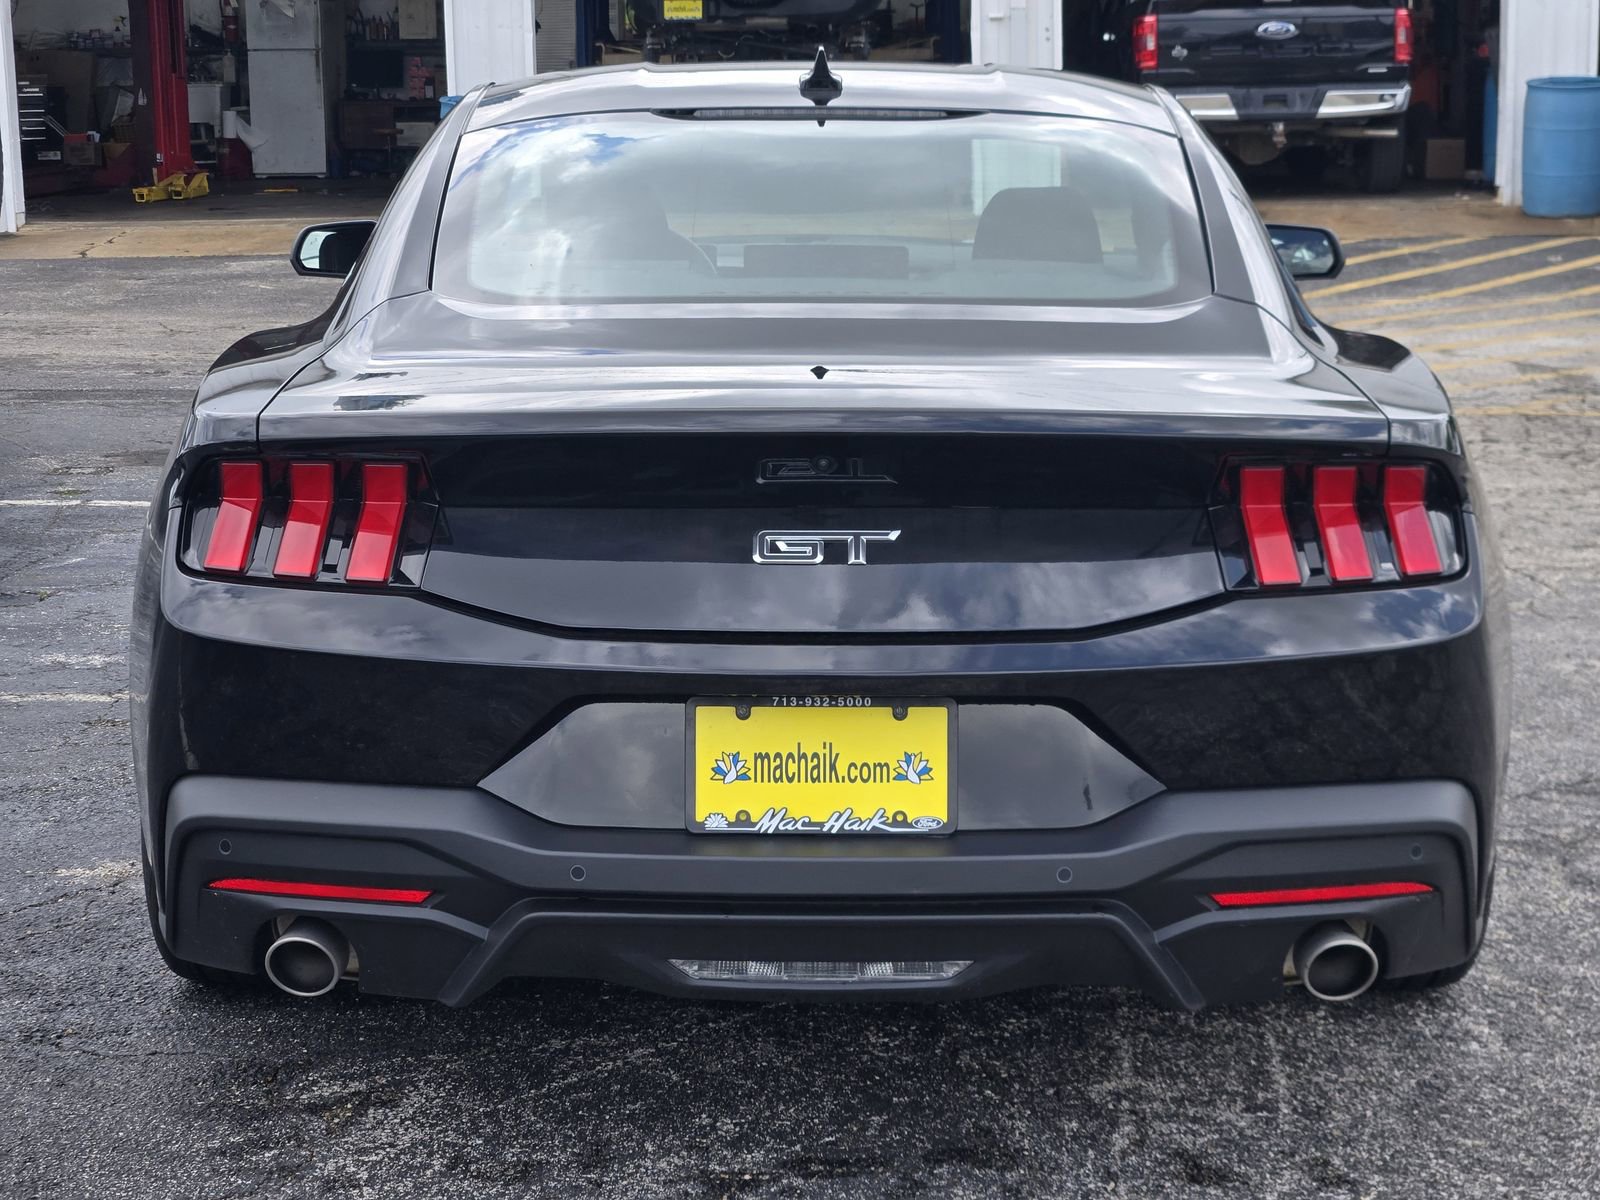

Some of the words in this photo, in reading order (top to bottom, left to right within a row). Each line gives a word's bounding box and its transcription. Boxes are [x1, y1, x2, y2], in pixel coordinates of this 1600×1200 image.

[752, 529, 901, 565] GT
[772, 696, 872, 707] 713-932-5000
[753, 742, 891, 784] machaik.com
[755, 808, 820, 833] Mac
[822, 808, 893, 833] Haik
